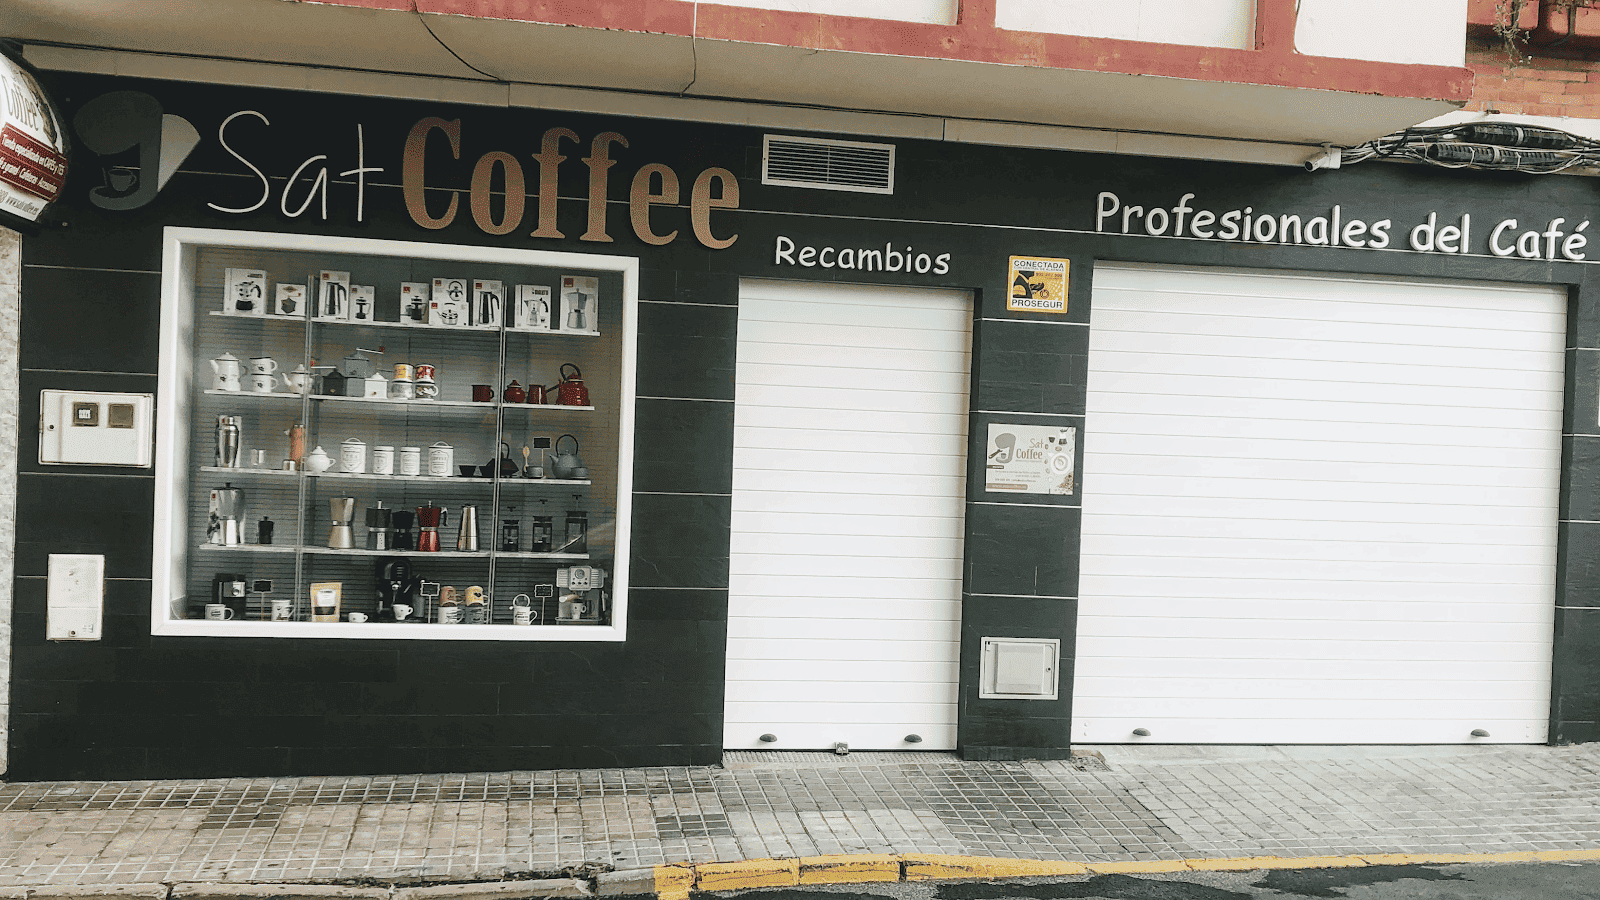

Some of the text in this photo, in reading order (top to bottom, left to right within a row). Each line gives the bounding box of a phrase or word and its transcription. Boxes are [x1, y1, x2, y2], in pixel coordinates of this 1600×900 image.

[1, 74, 38, 131] Coffee
[208, 109, 739, 249] Sat Coffee
[1095, 191, 1590, 261] Profesionales del Café
[775, 235, 951, 275] Recambios
[1013, 260, 1064, 269] CONECTADA
[1011, 299, 1063, 308] PROSEGUR
[1016, 448, 1042, 459] Coffee
[1029, 438, 1044, 448] Sat
